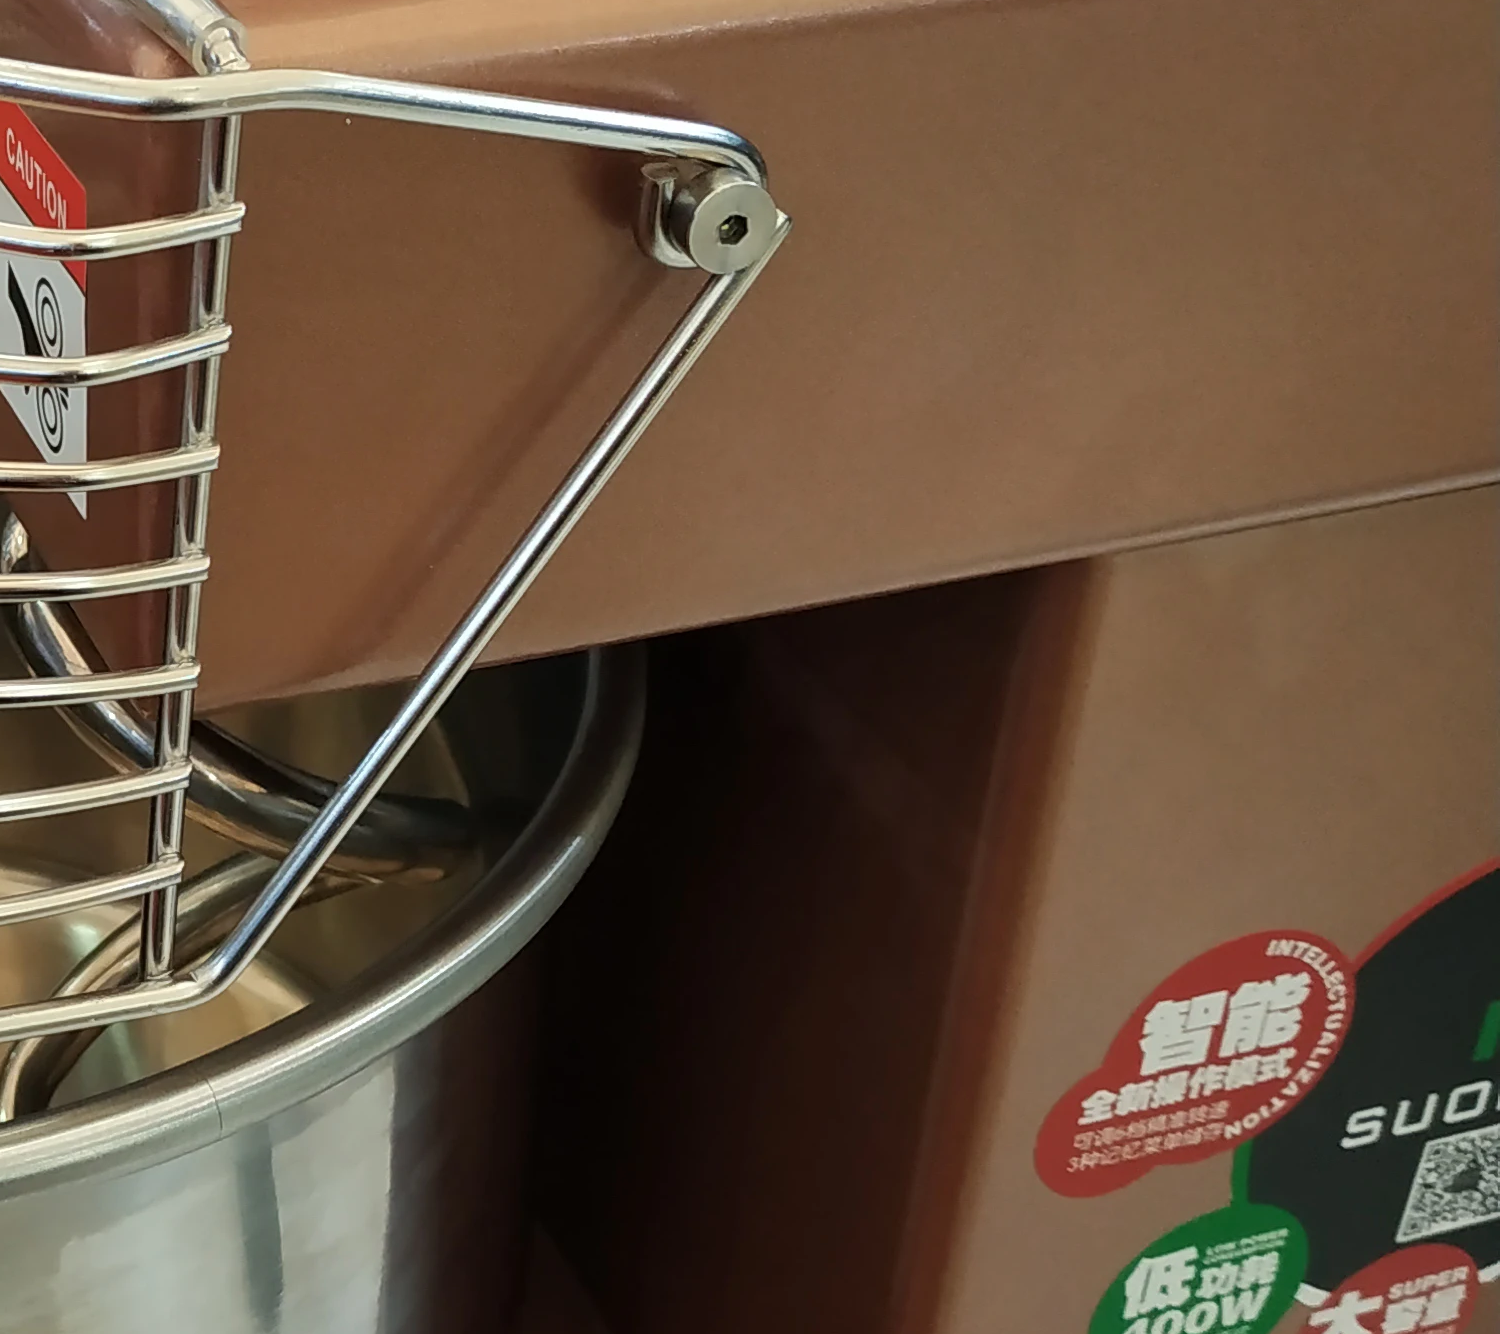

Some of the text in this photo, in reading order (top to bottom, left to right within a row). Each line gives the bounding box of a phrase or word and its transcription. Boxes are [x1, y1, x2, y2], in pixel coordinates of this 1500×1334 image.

[6, 126, 68, 230] CAUTION
[1139, 971, 1312, 1076] 智能
[1077, 1047, 1297, 1125] 全新操作模式
[1340, 1079, 1500, 1150] SUO
[1387, 1265, 1470, 1300] SUPER
